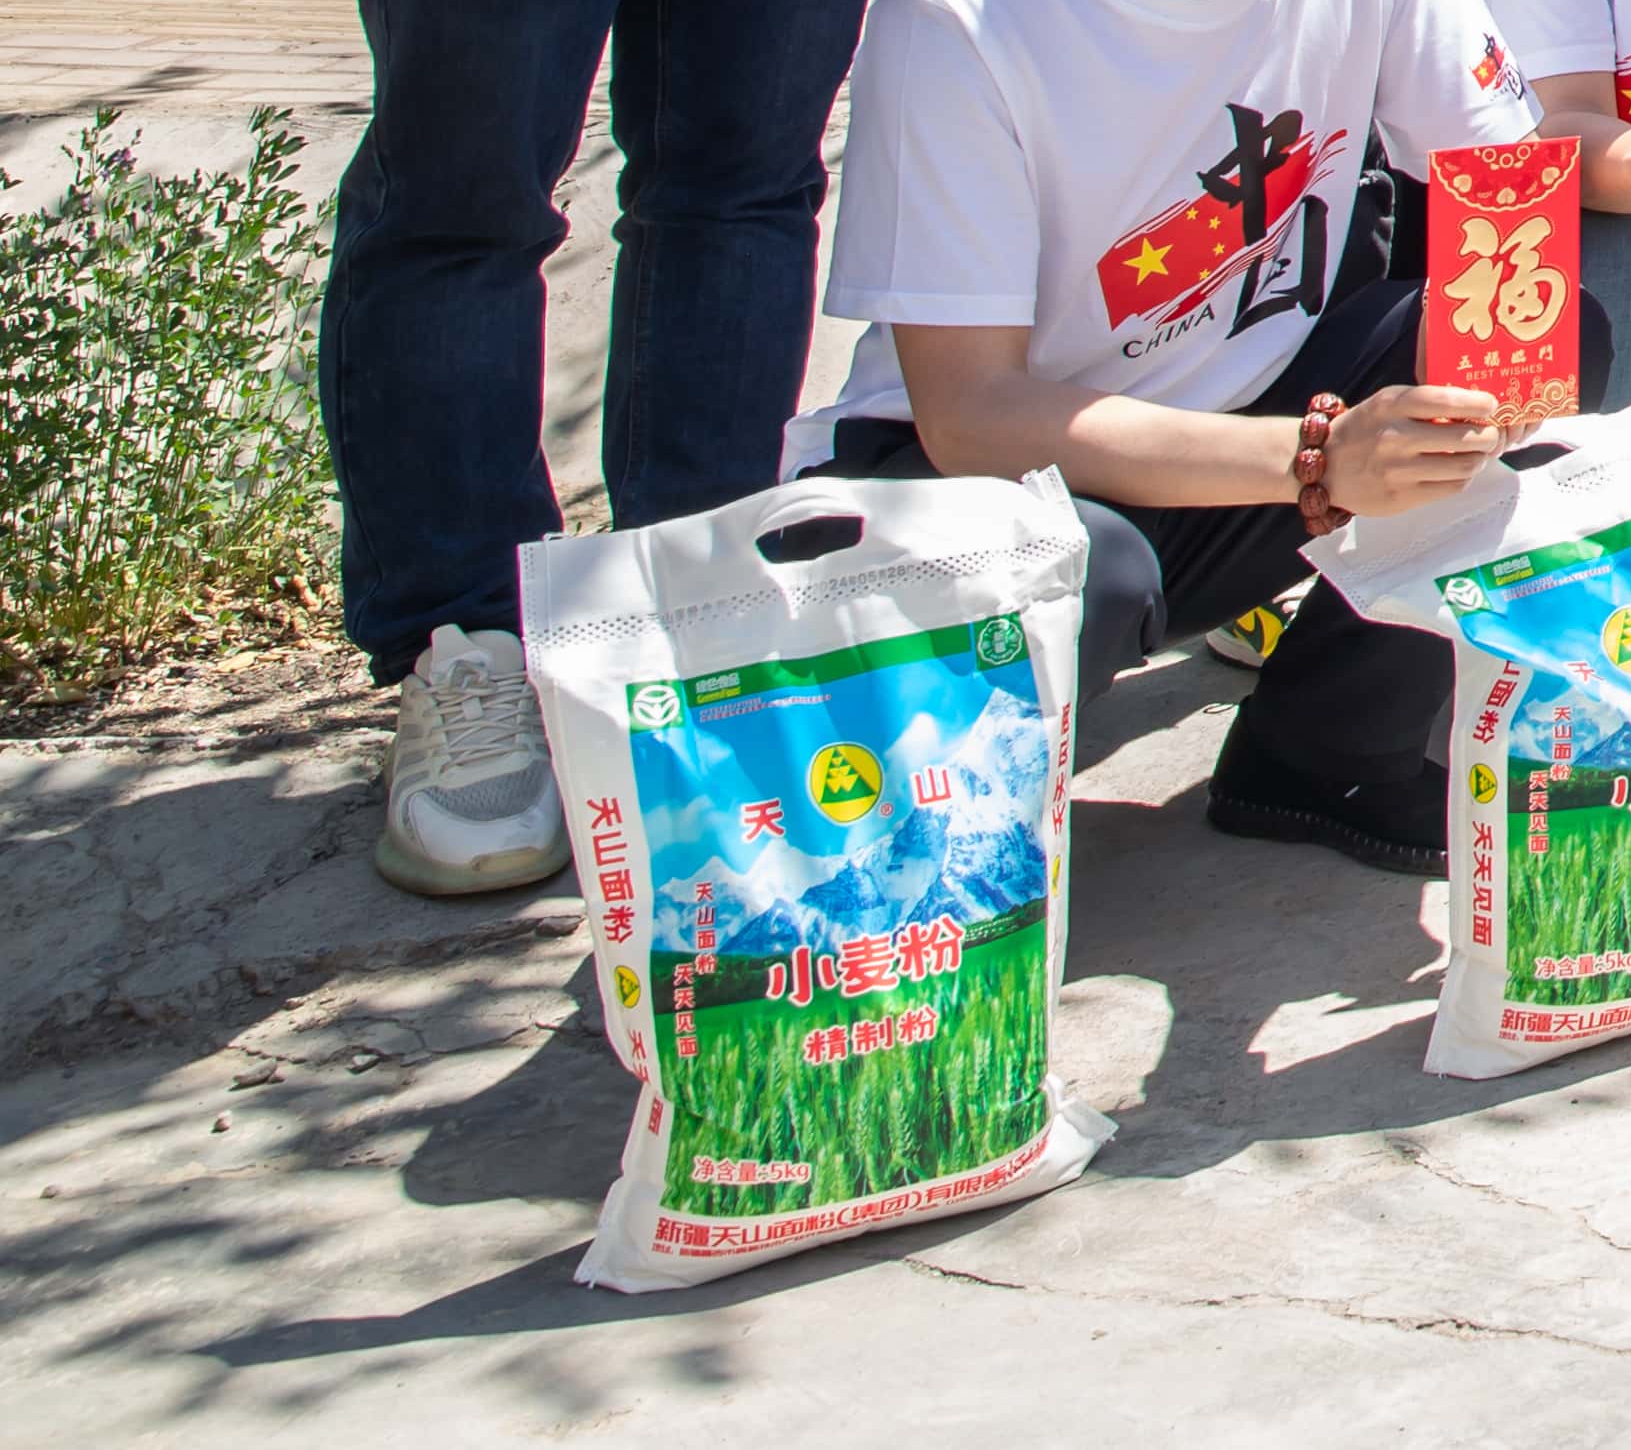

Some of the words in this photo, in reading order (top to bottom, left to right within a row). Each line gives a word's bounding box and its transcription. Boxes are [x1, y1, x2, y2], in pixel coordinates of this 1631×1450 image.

[1197, 101, 1329, 340] 中国
[1441, 214, 1569, 343] 福
[1121, 302, 1216, 360] CHINA
[1464, 369, 1495, 381] BEST
[1499, 363, 1545, 377] WISHES
[1550, 706, 1572, 782] 天山面粉
[740, 798, 786, 843] 天
[913, 760, 954, 806] 山
[1528, 770, 1550, 855] 天天见面
[584, 795, 634, 945] 天山面粉
[1472, 820, 1494, 948] 天天见面
[694, 881, 717, 976] 天山面粉
[765, 913, 967, 1008] 小麦粉
[673, 961, 702, 1058] 天天见面
[803, 1007, 940, 1066] 精制粉
